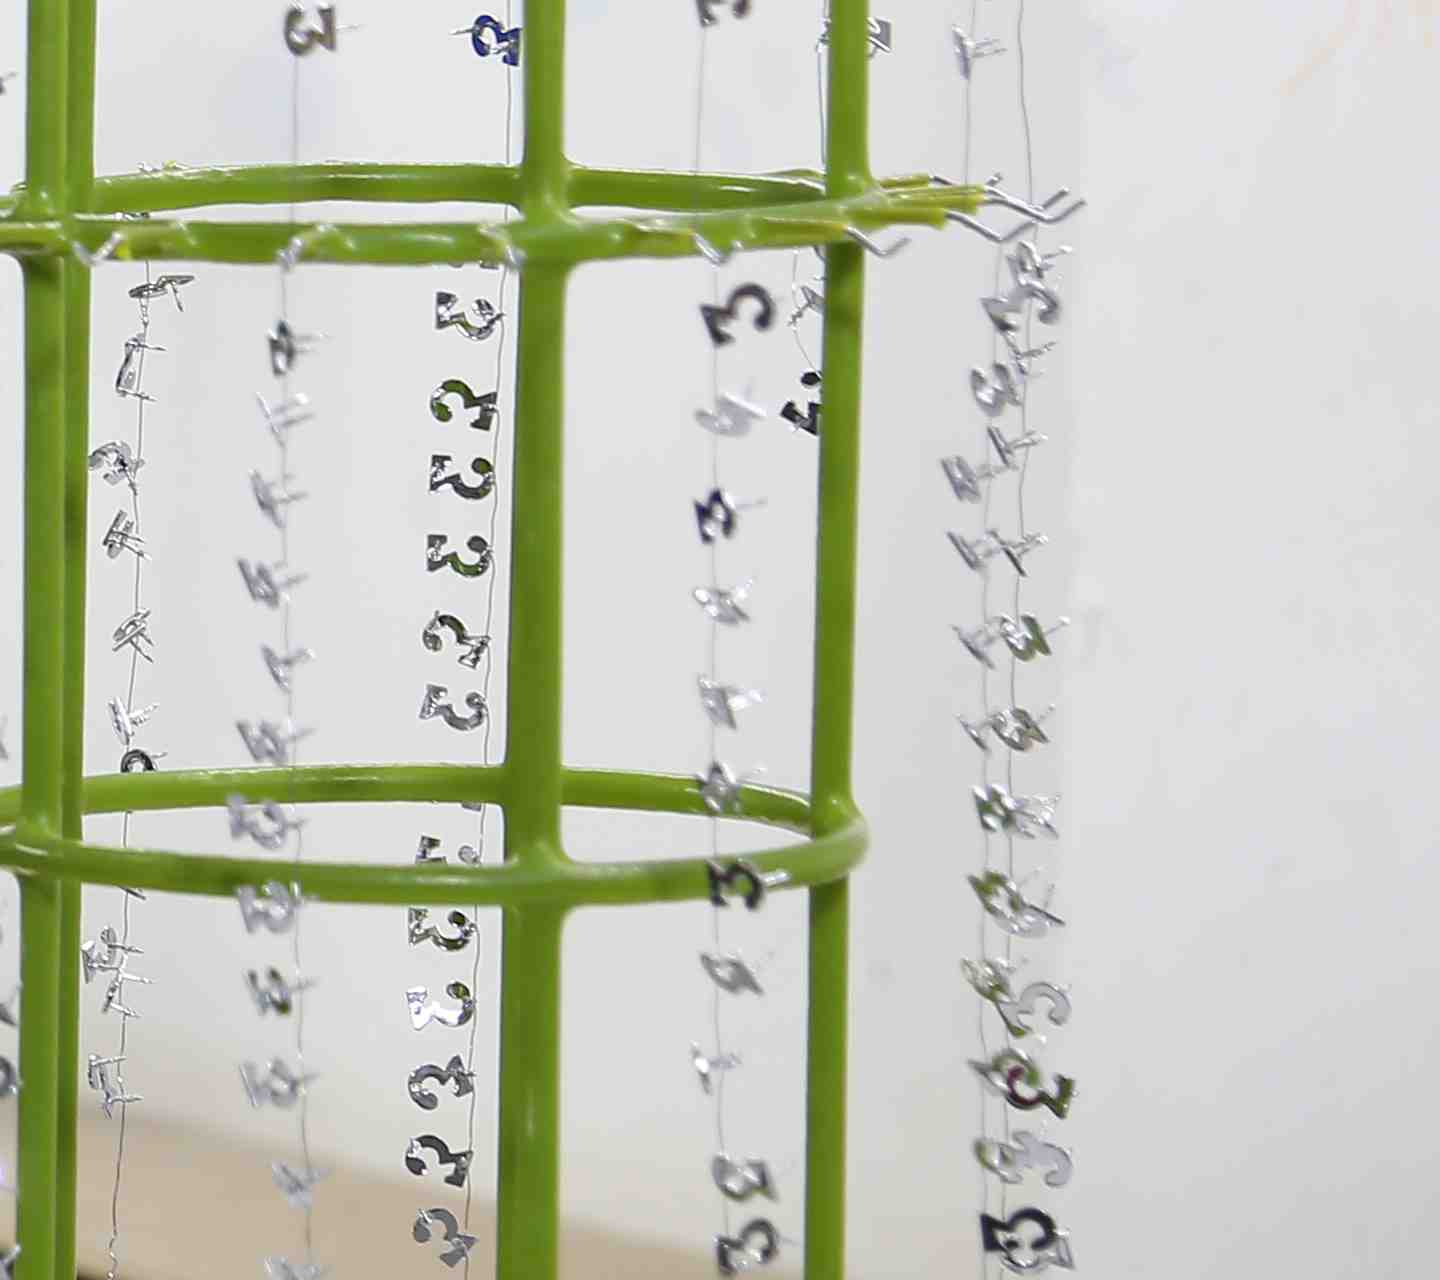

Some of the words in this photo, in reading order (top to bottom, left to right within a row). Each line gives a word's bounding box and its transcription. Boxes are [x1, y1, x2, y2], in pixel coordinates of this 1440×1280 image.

[284, 6, 336, 57] 3
[701, 282, 775, 347] 3
[707, 860, 764, 910] 3
[712, 1155, 778, 1201] 3
[715, 1219, 778, 1278] 3
